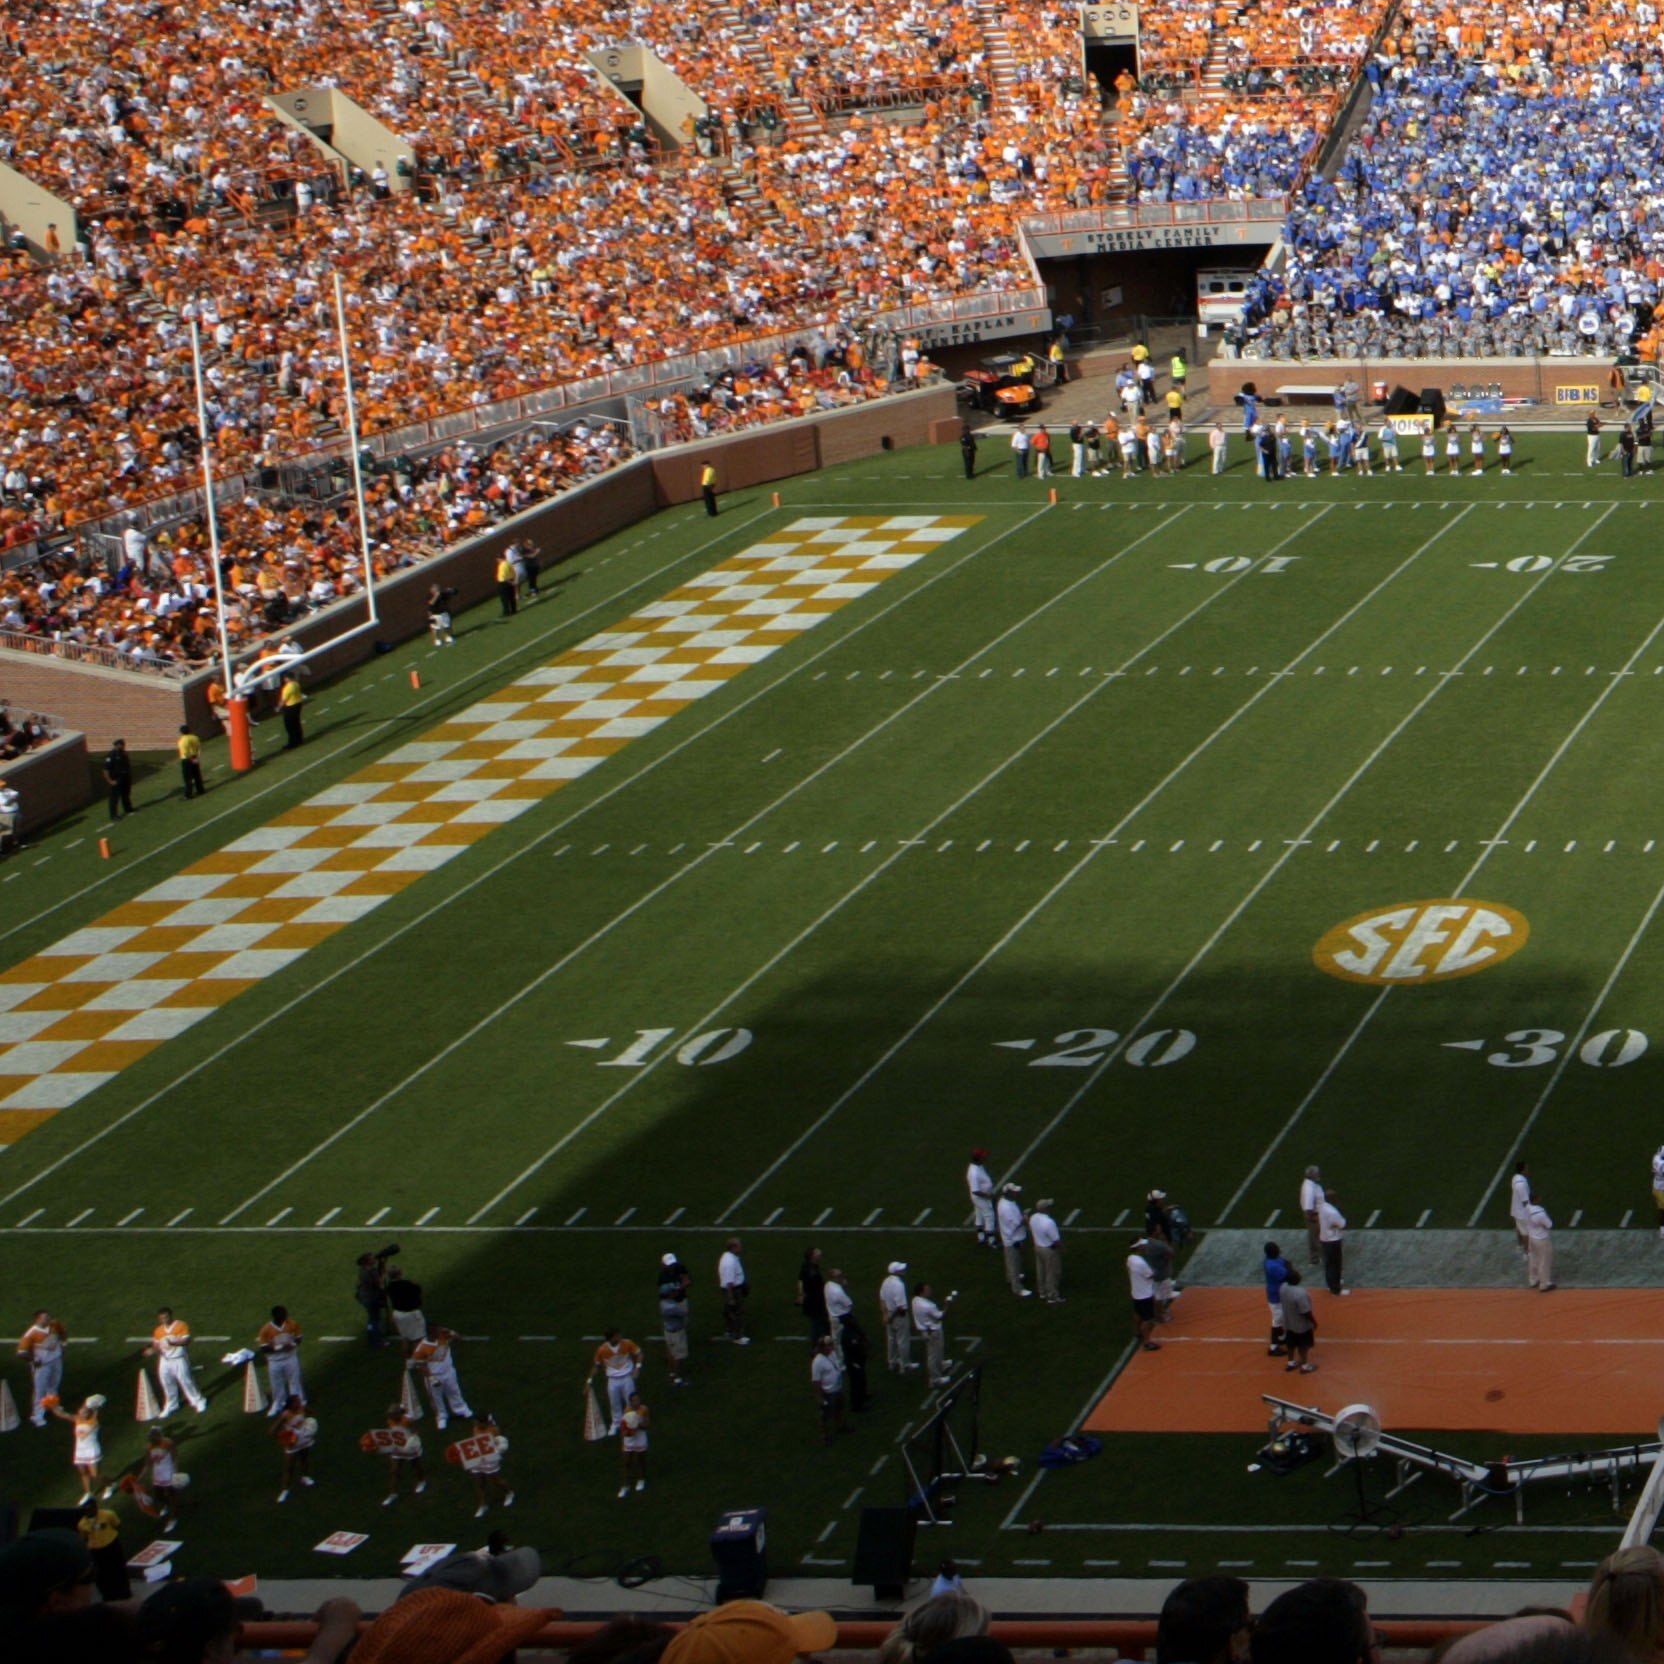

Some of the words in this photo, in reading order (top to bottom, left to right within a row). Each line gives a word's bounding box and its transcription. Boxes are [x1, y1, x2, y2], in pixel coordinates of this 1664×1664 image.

[1087, 230, 1153, 243] STOKELY
[1163, 227, 1219, 238] FAMILY
[1097, 239, 1146, 253] MEDIA
[1154, 236, 1213, 248] CENTER
[950, 317, 1015, 334] KAPLAN
[1331, 904, 1512, 979] SEC
[597, 1027, 754, 1068] 10
[1027, 1028, 1197, 1069] 20
[1486, 1028, 1649, 1068] 30
[375, 1430, 408, 1447] SS
[459, 1434, 496, 1460] EE
